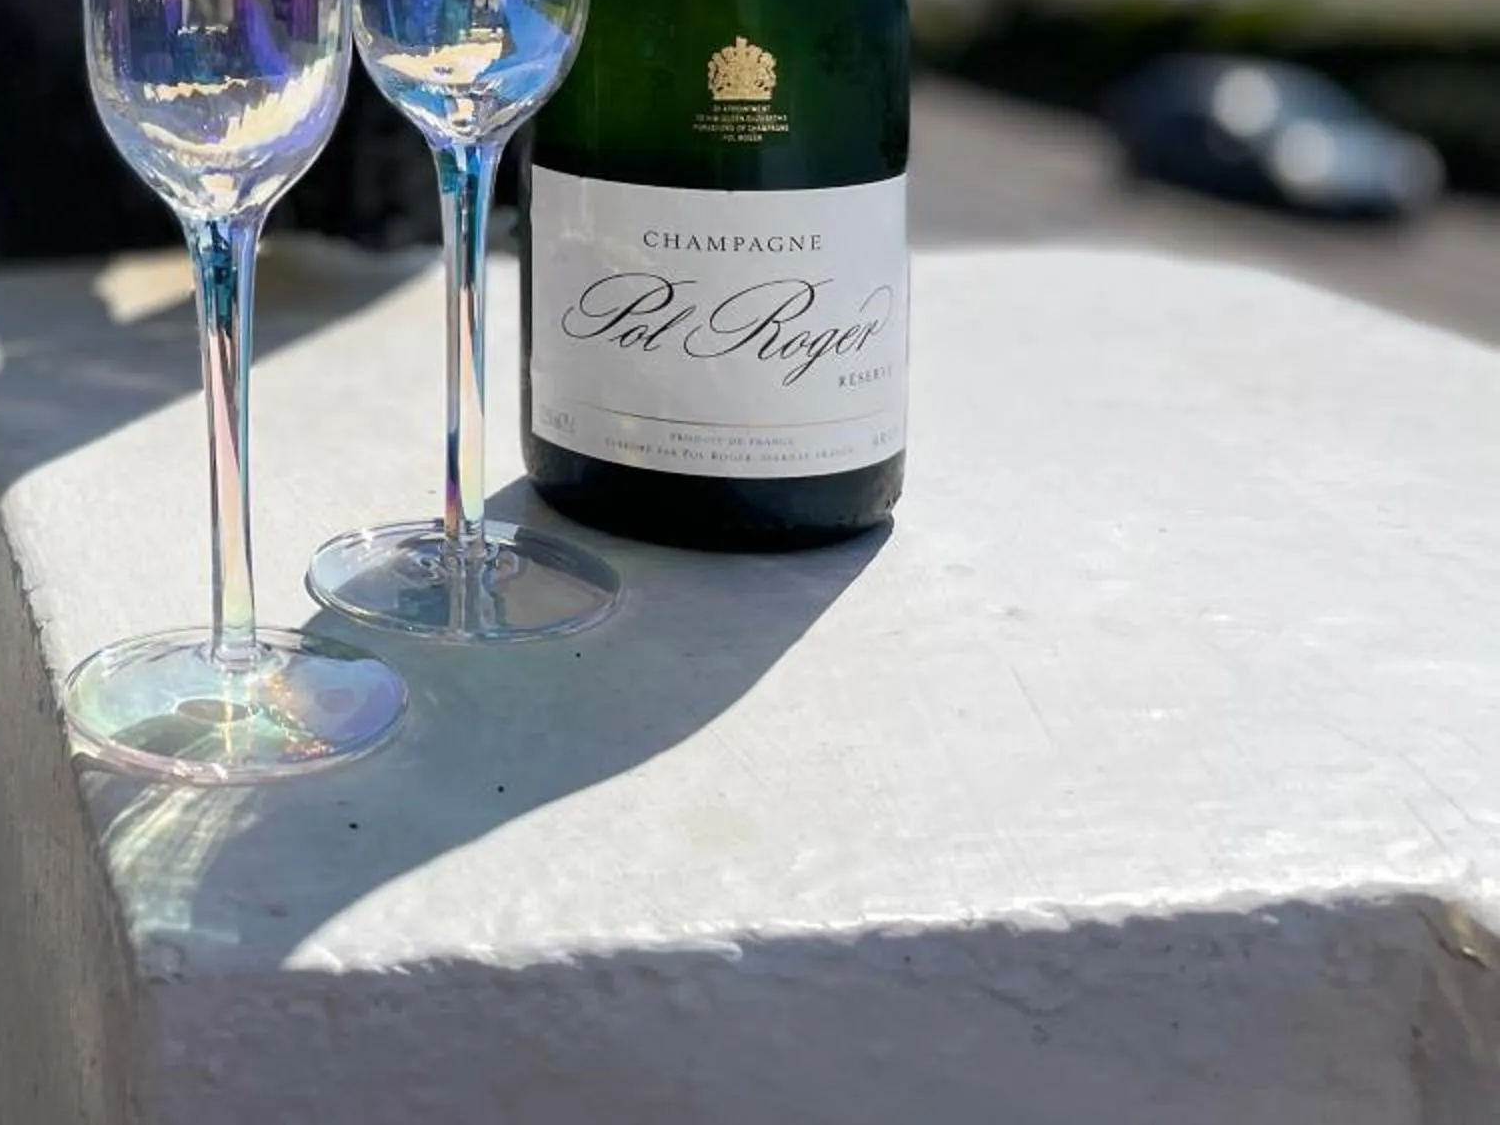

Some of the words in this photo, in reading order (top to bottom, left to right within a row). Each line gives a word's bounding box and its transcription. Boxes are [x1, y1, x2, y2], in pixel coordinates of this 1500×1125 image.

[642, 229, 823, 253] CHAMPAGNE
[561, 272, 698, 352] Pol
[684, 277, 894, 387] Roger
